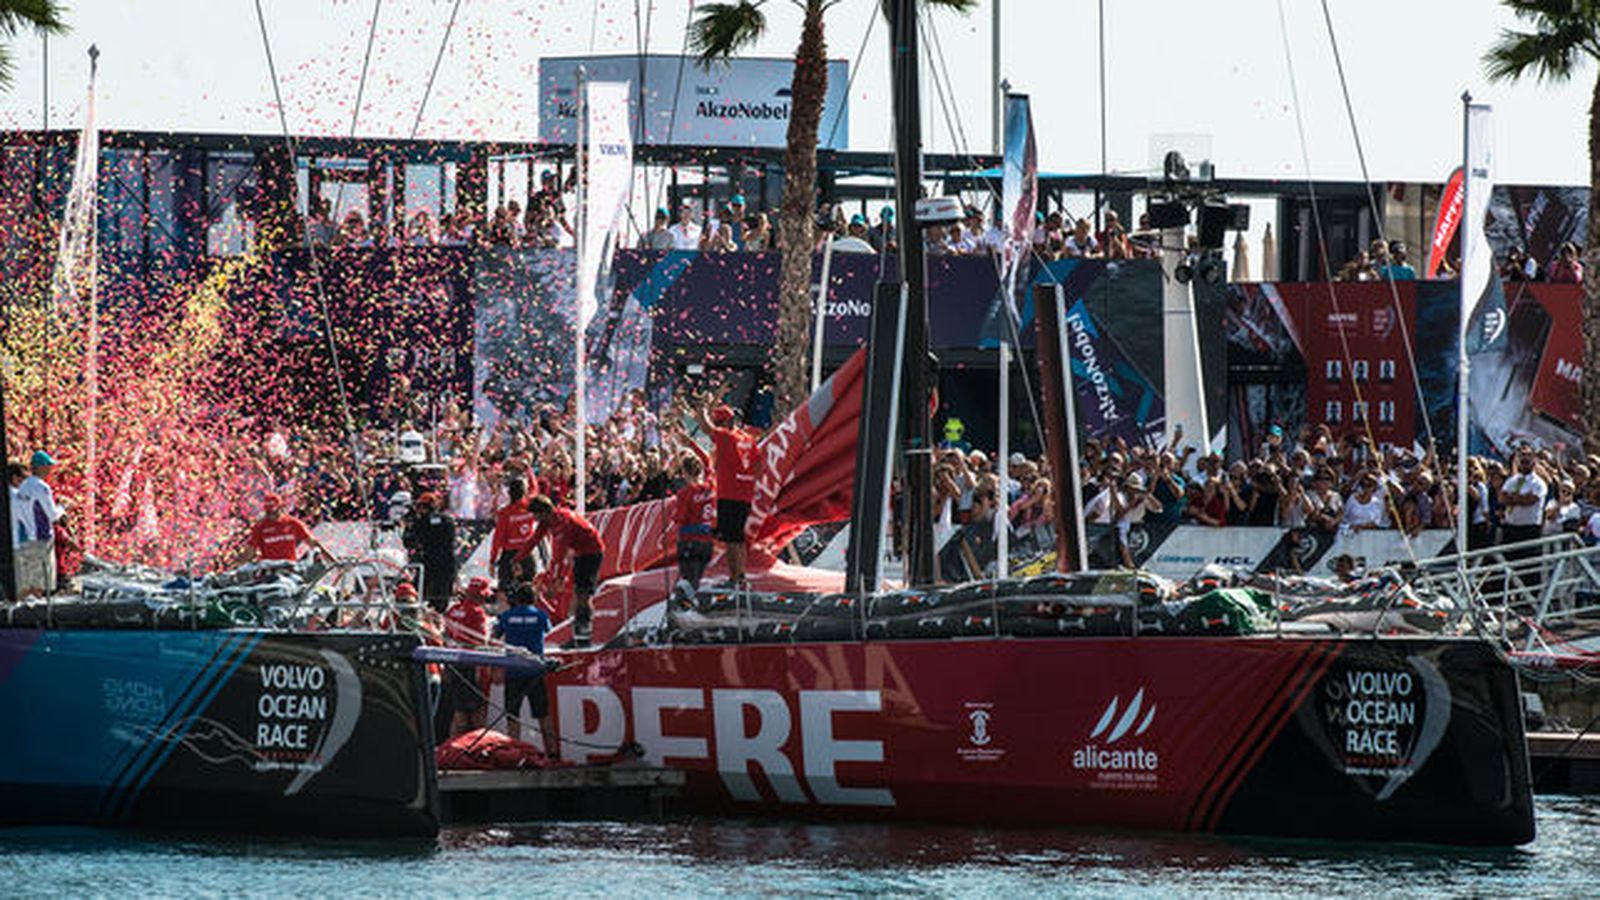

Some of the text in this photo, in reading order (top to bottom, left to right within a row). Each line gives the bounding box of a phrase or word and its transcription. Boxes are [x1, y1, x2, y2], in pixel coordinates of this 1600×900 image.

[696, 101, 789, 120] AkzoNobel
[1066, 313, 1120, 420] AkzoNobel
[1214, 555, 1255, 566] HCL
[260, 665, 325, 690] VOLVO
[1346, 671, 1413, 696] VOLVO
[258, 694, 327, 719] OCEAN
[1345, 700, 1415, 725] OCEAN
[257, 724, 308, 749] RACE
[1346, 729, 1398, 754] RACE
[1073, 745, 1158, 769] alicante
